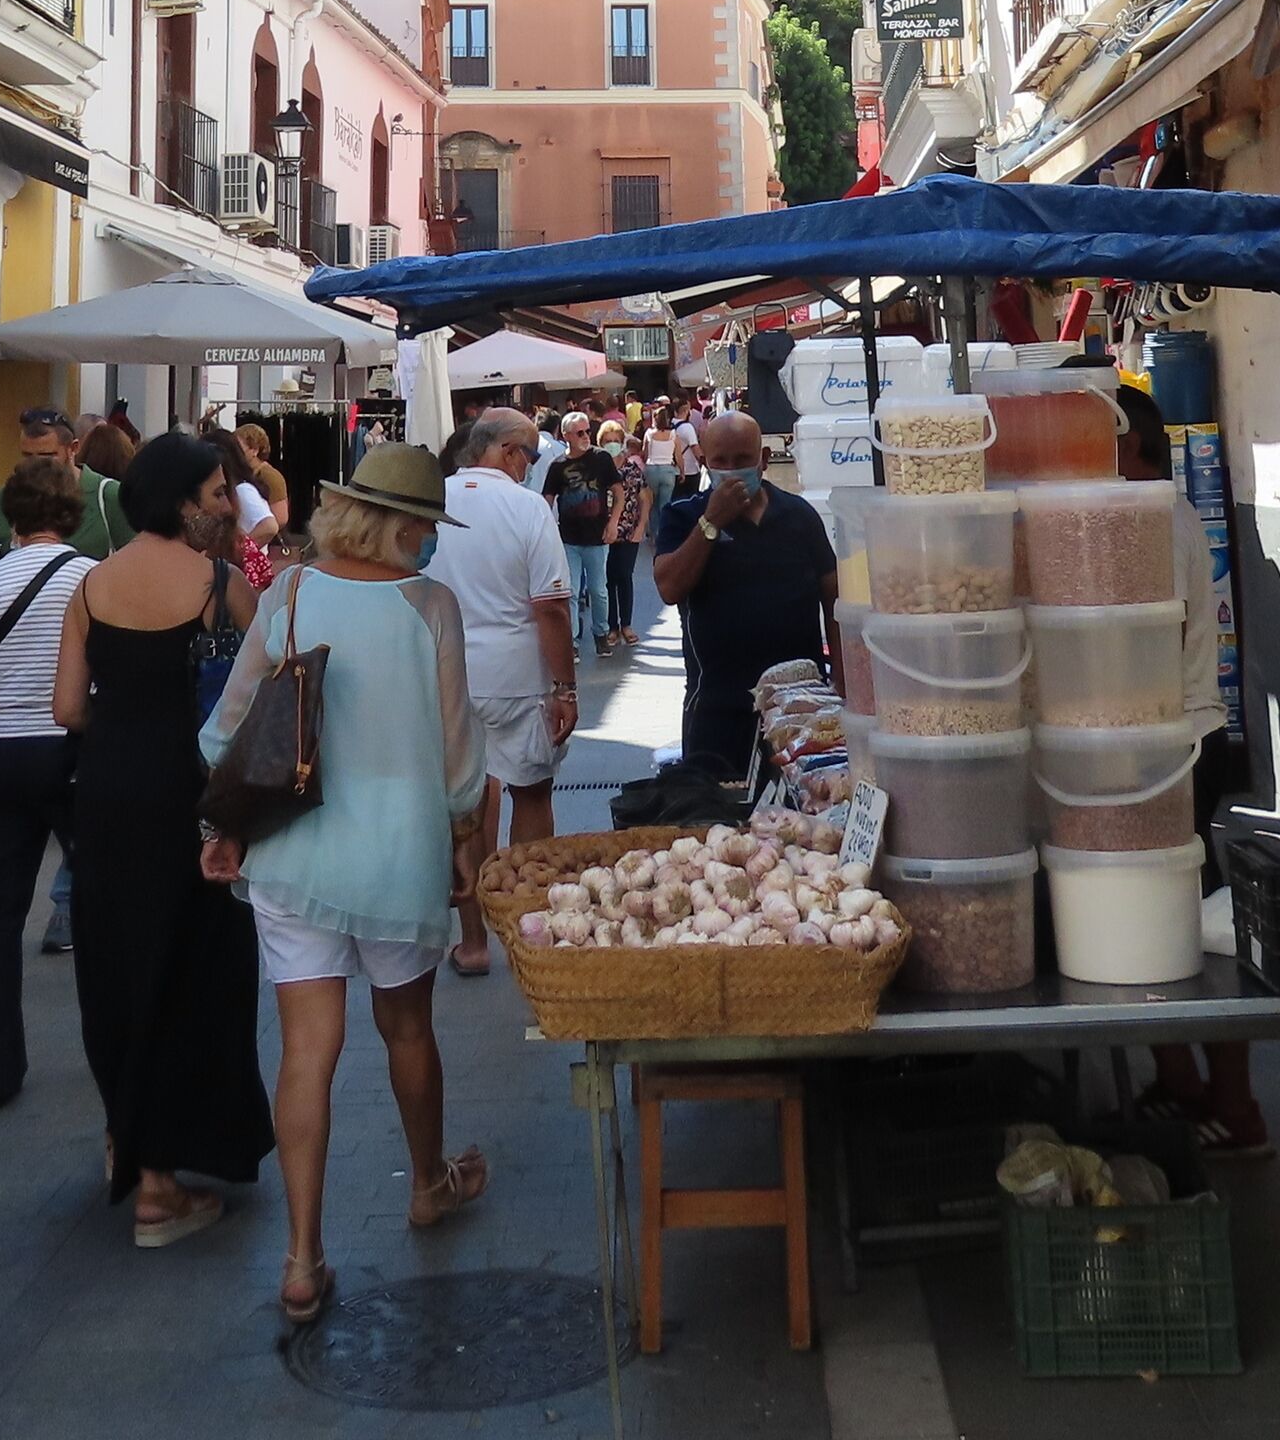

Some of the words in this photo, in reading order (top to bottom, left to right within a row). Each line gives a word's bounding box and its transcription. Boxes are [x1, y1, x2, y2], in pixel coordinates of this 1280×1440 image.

[881, 19, 931, 30] TERRAZA
[938, 18, 959, 28] BAR
[893, 28, 951, 39] MOMENTOS
[205, 348, 260, 362] CERVEZAS
[263, 348, 326, 363] ALHAMBRA
[831, 451, 873, 463] Polar
